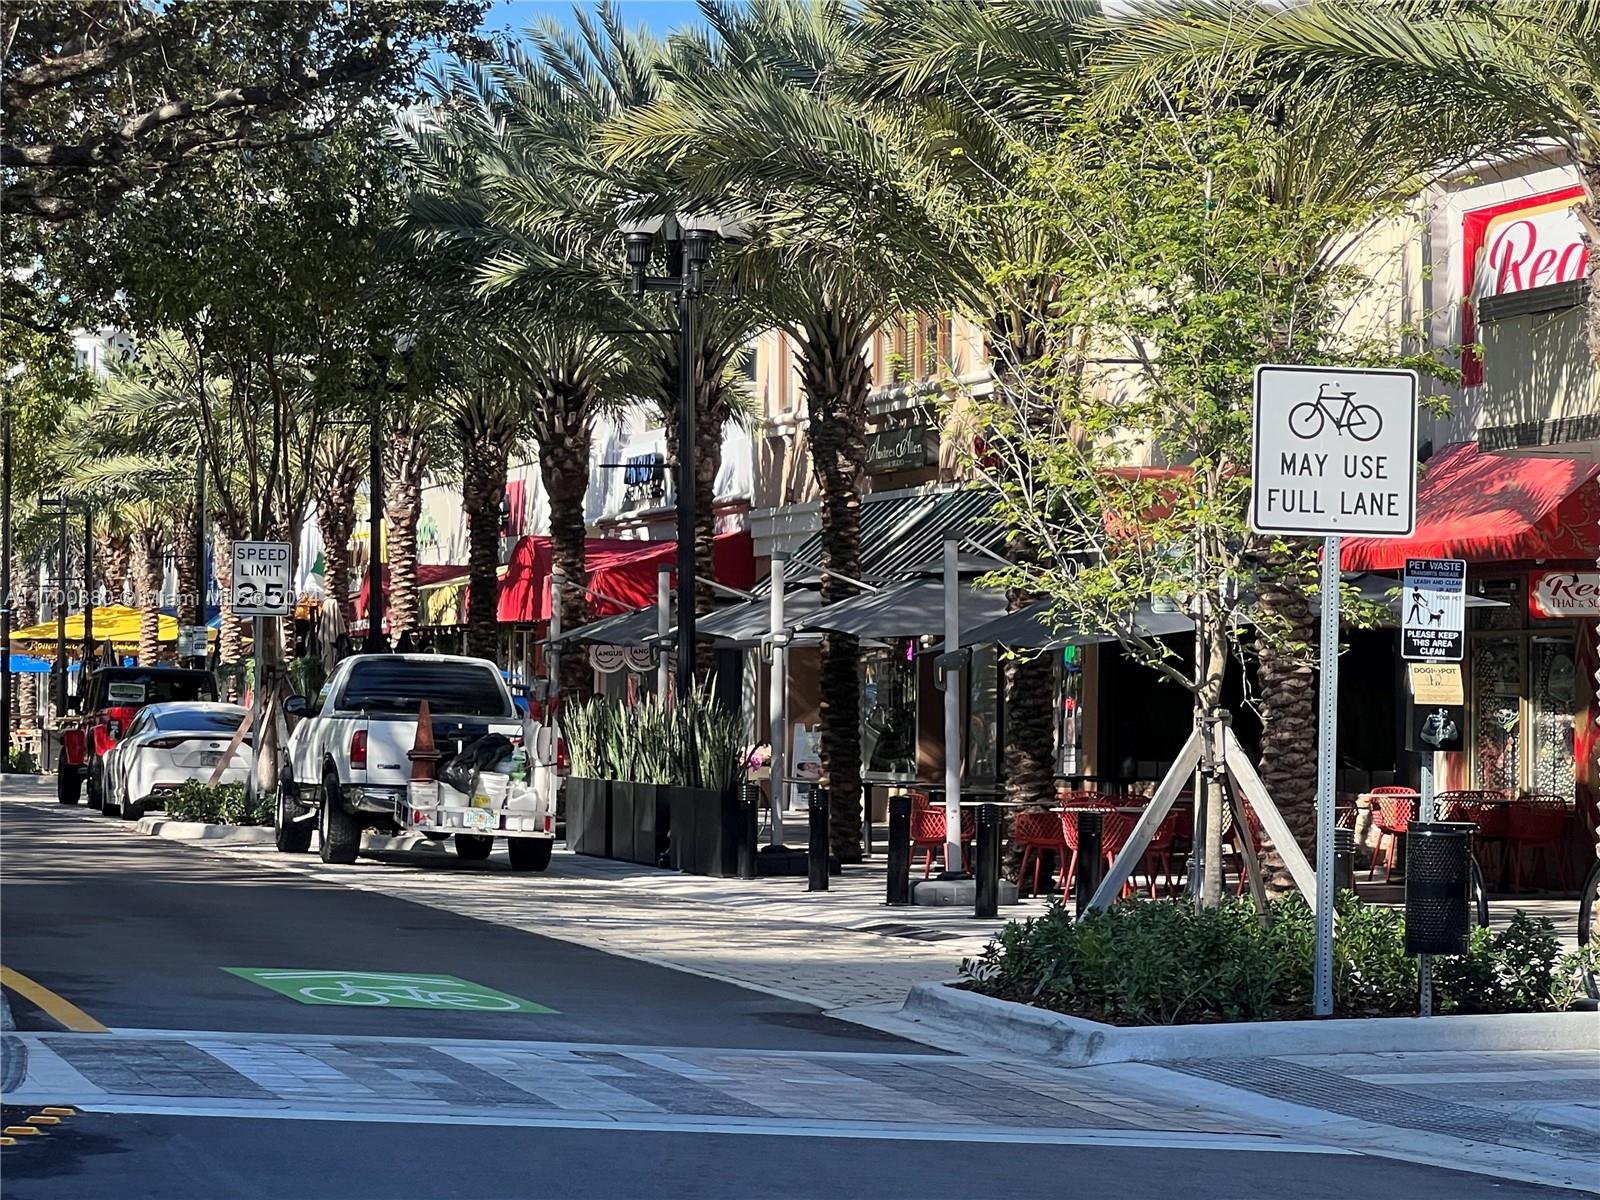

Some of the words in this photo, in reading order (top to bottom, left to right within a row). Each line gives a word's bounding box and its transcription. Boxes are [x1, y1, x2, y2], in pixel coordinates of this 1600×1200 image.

[1280, 452, 1329, 477] MAY
[1344, 455, 1388, 479] USE
[1267, 488, 1325, 514] FULL
[1340, 491, 1399, 516] LANE
[237, 548, 288, 561] SPEED
[241, 564, 282, 577] LIMIT
[1408, 560, 1427, 570] PET
[1429, 561, 1462, 571] WASTE
[1546, 572, 1600, 602] Re
[236, 582, 285, 609] 25
[1551, 597, 1575, 608] THAI
[1407, 630, 1436, 639] PLEASE
[1438, 631, 1459, 640] KEEP
[1413, 639, 1431, 647] THIS
[1432, 639, 1453, 648] AREA
